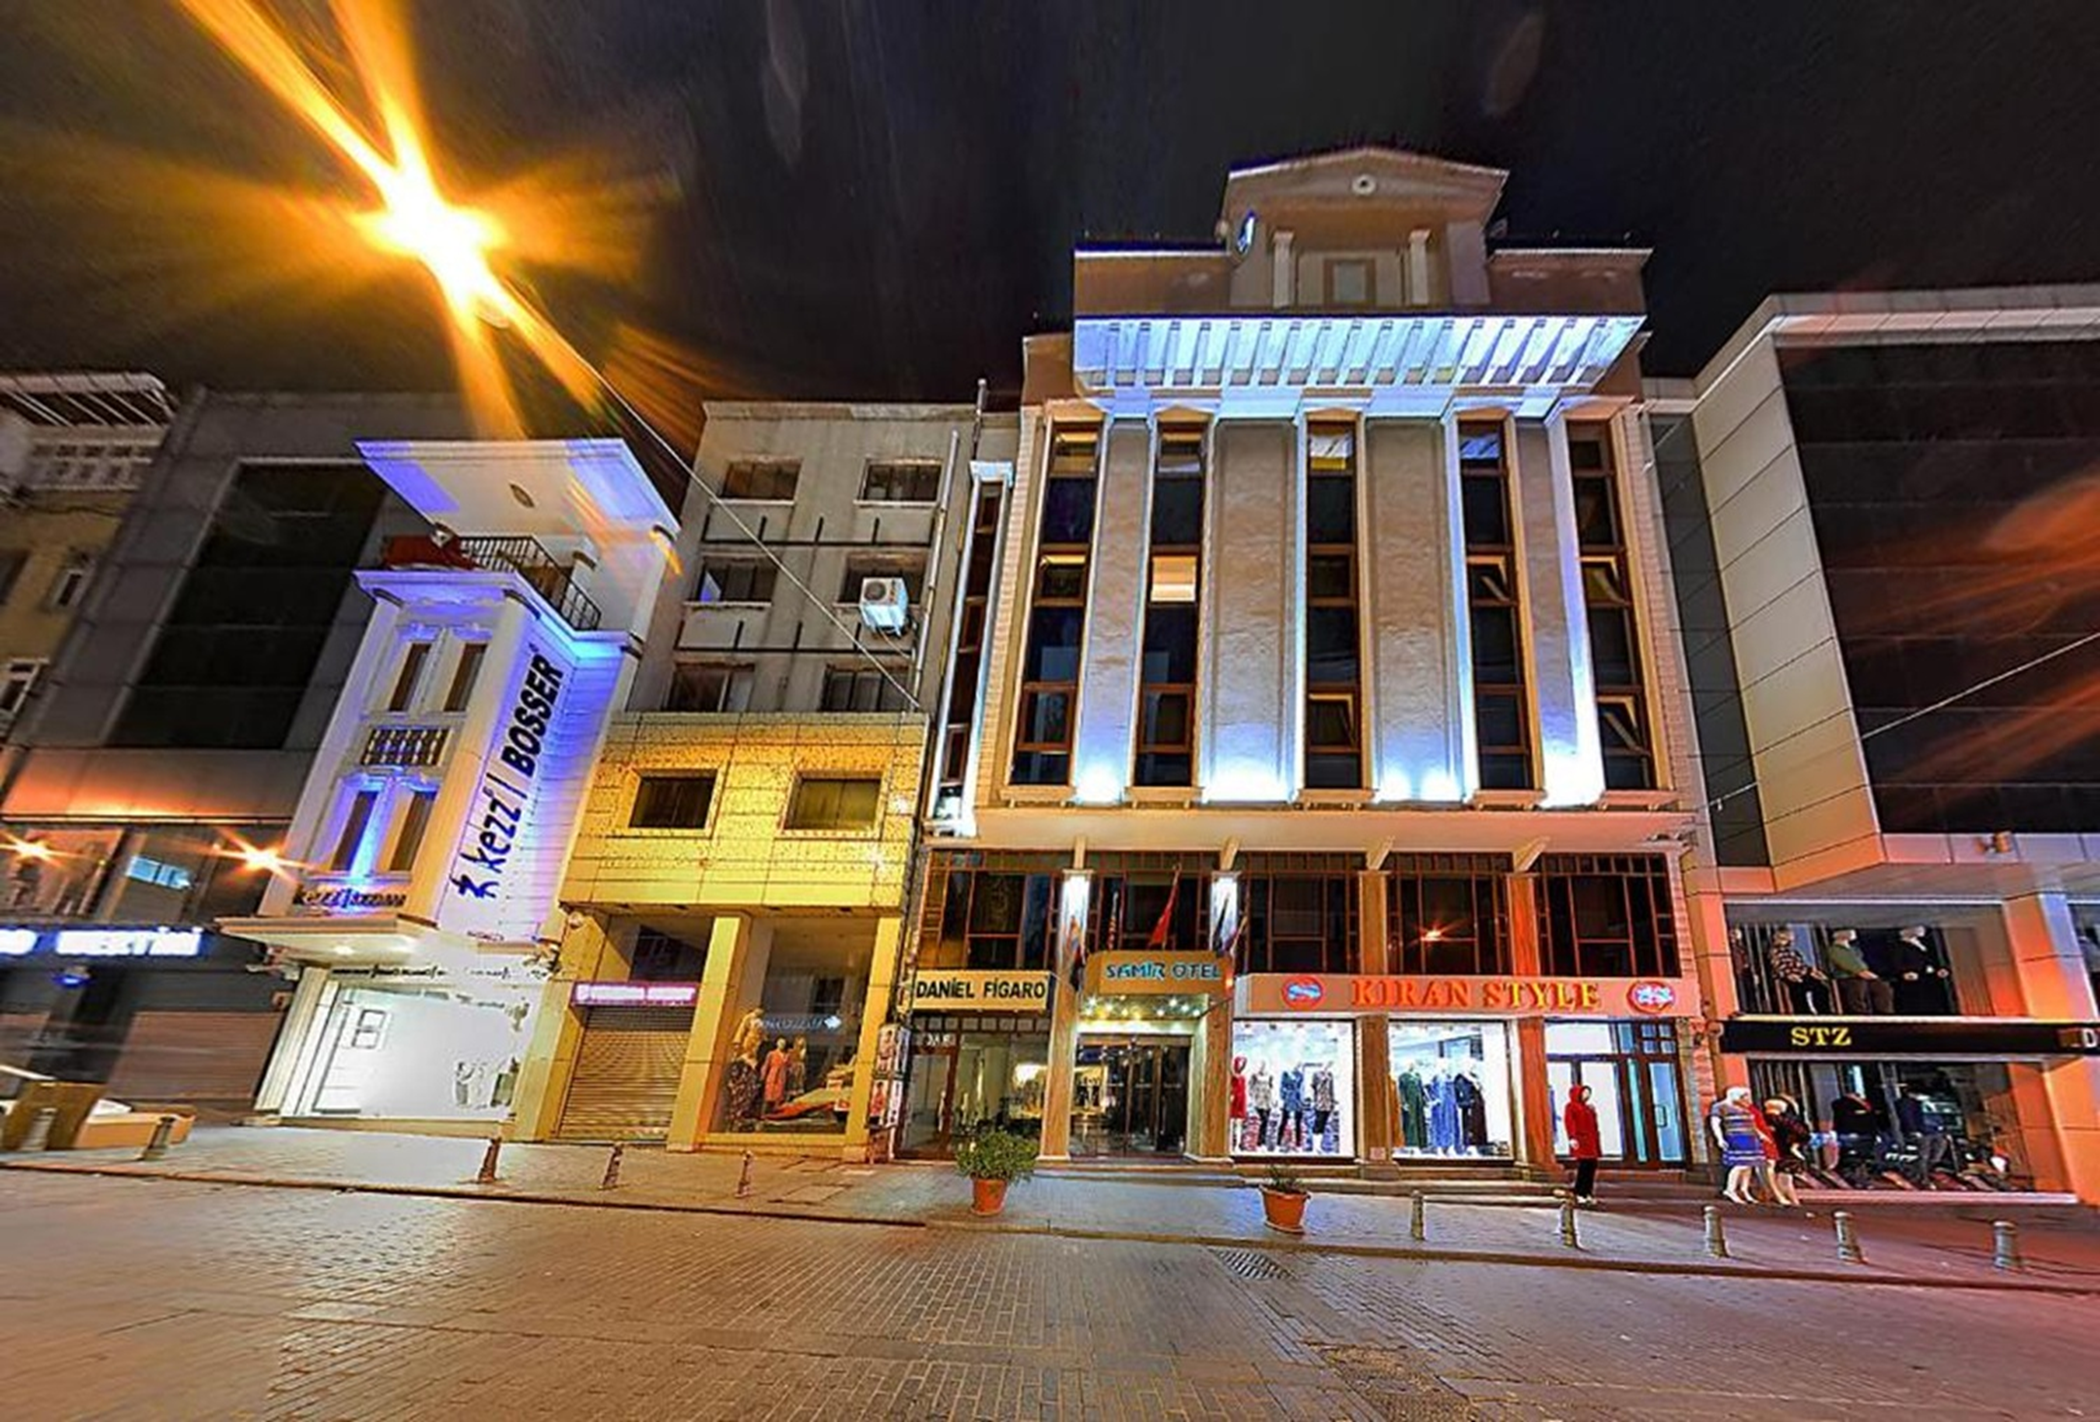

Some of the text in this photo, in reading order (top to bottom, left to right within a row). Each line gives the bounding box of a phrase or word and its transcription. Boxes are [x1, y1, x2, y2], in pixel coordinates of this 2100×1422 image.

[501, 654, 564, 777] BOSSER
[1172, 965, 1221, 980] OTEL
[1352, 978, 1600, 1010] KIRAN STYLE
[1790, 1026, 1852, 1046] STZ
